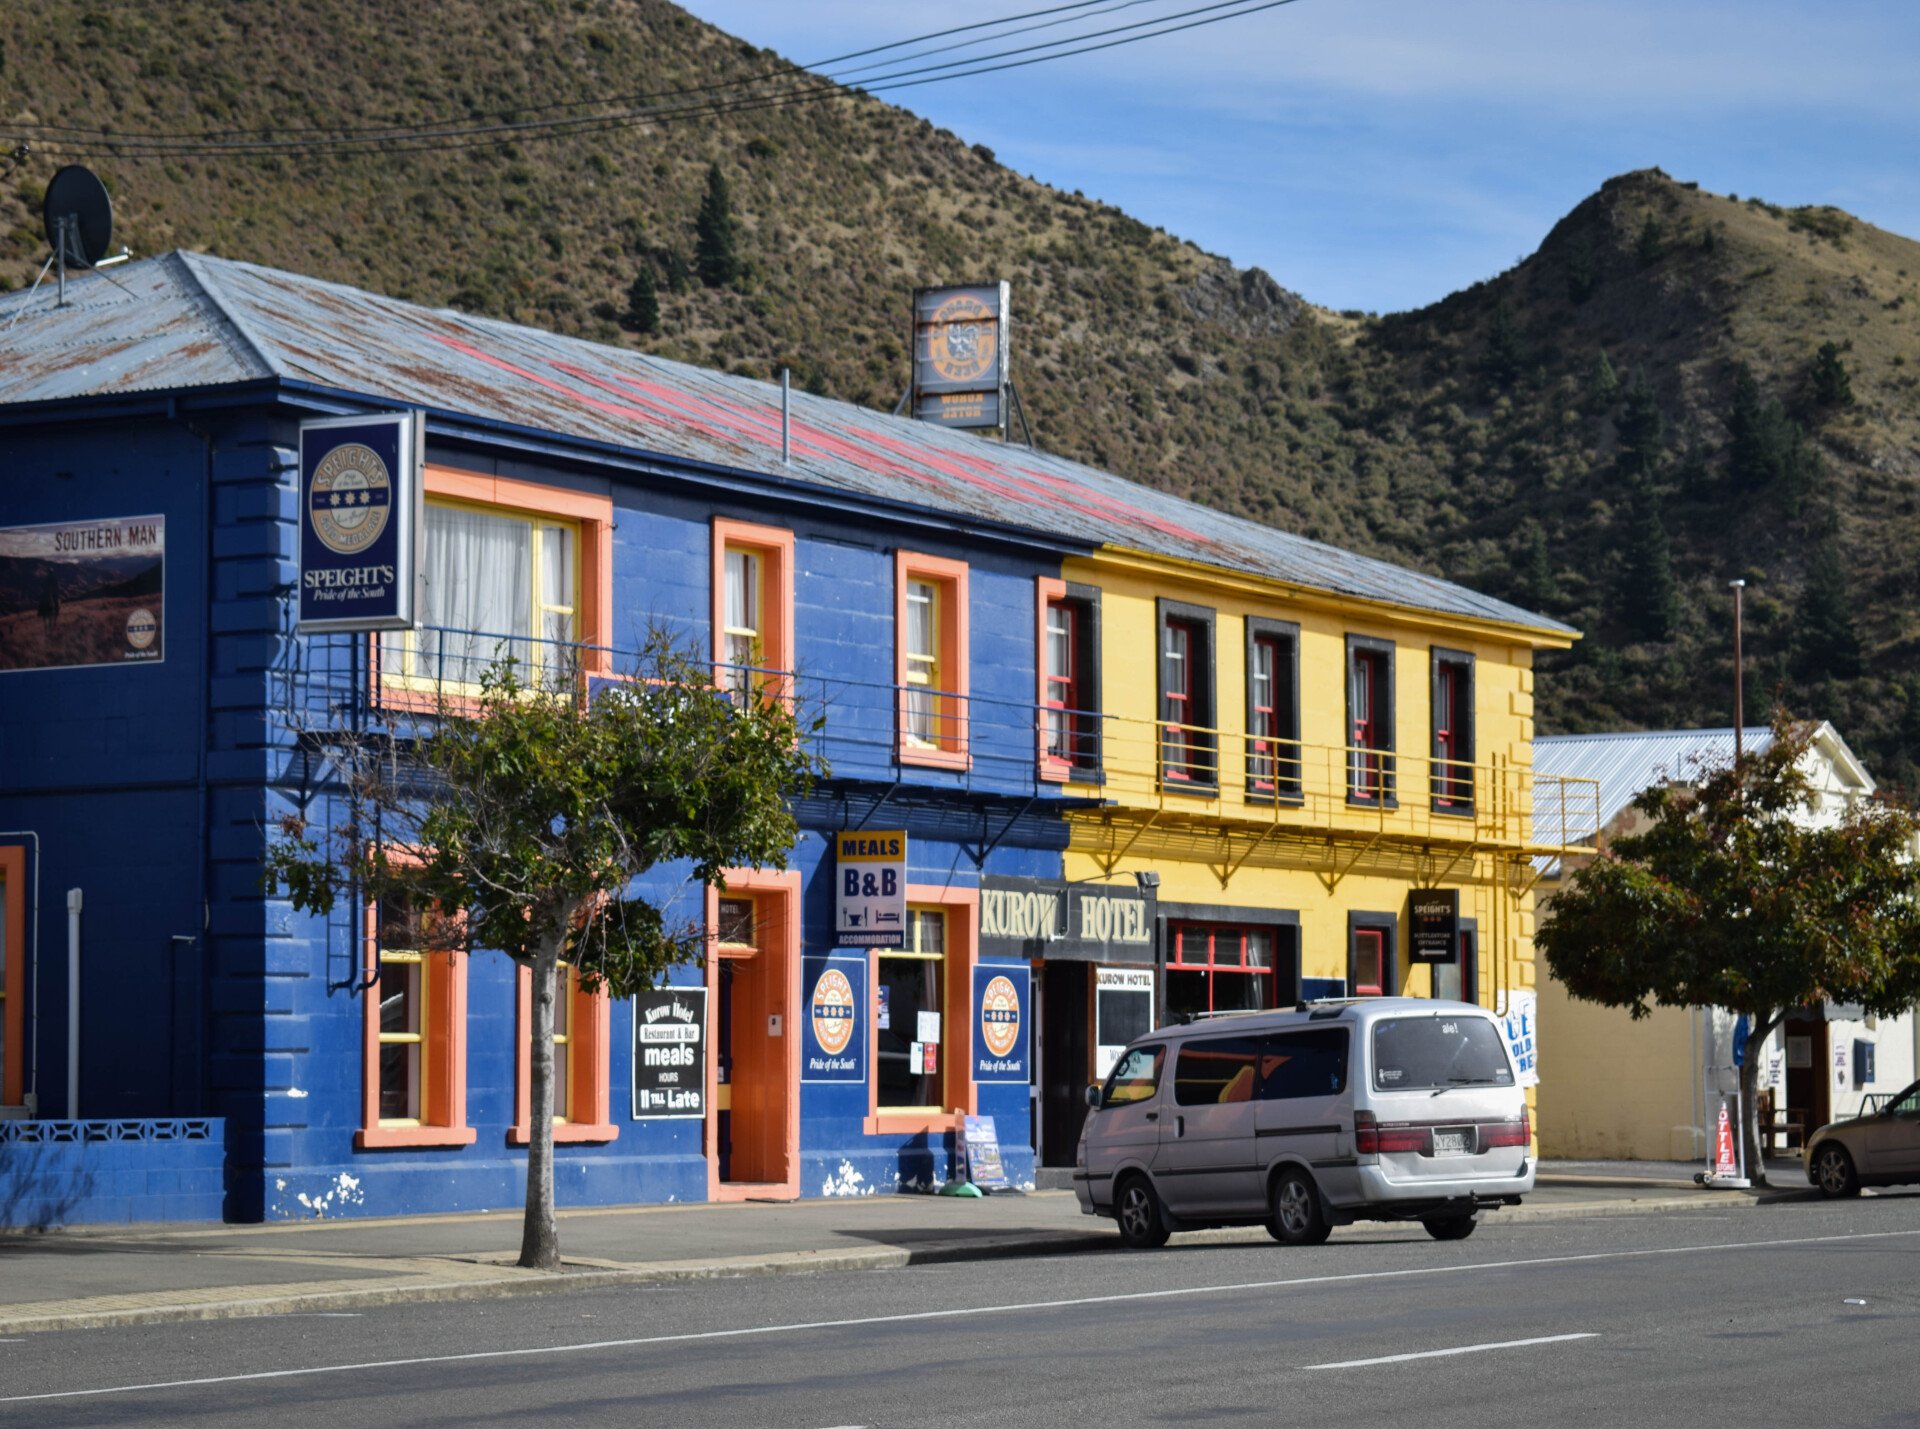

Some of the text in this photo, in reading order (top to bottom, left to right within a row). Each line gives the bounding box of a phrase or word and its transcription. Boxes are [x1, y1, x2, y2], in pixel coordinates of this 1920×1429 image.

[55, 525, 157, 551] SOUTHERN MAN
[304, 565, 394, 588] SPEIGHT'S
[313, 586, 385, 602] Pride of the South
[842, 839, 899, 856] MEALS
[844, 868, 897, 897] B&B
[981, 889, 1150, 942] KUROW HOTEL
[1414, 905, 1451, 914] SPEIGHT'S
[839, 934, 901, 945] ACCOMMODATION
[1097, 973, 1151, 986] KUROW HOTEL
[645, 1002, 694, 1024] Kurow Hotel
[644, 1027, 675, 1040] Restaurant
[685, 1027, 695, 1039] Bar
[644, 1042, 694, 1066] meals
[1512, 1037, 1532, 1057] OLD
[810, 1057, 824, 1070] Pride
[980, 1060, 992, 1071] Pride
[659, 1072, 679, 1083] HOURS
[668, 1089, 700, 1109] Late
